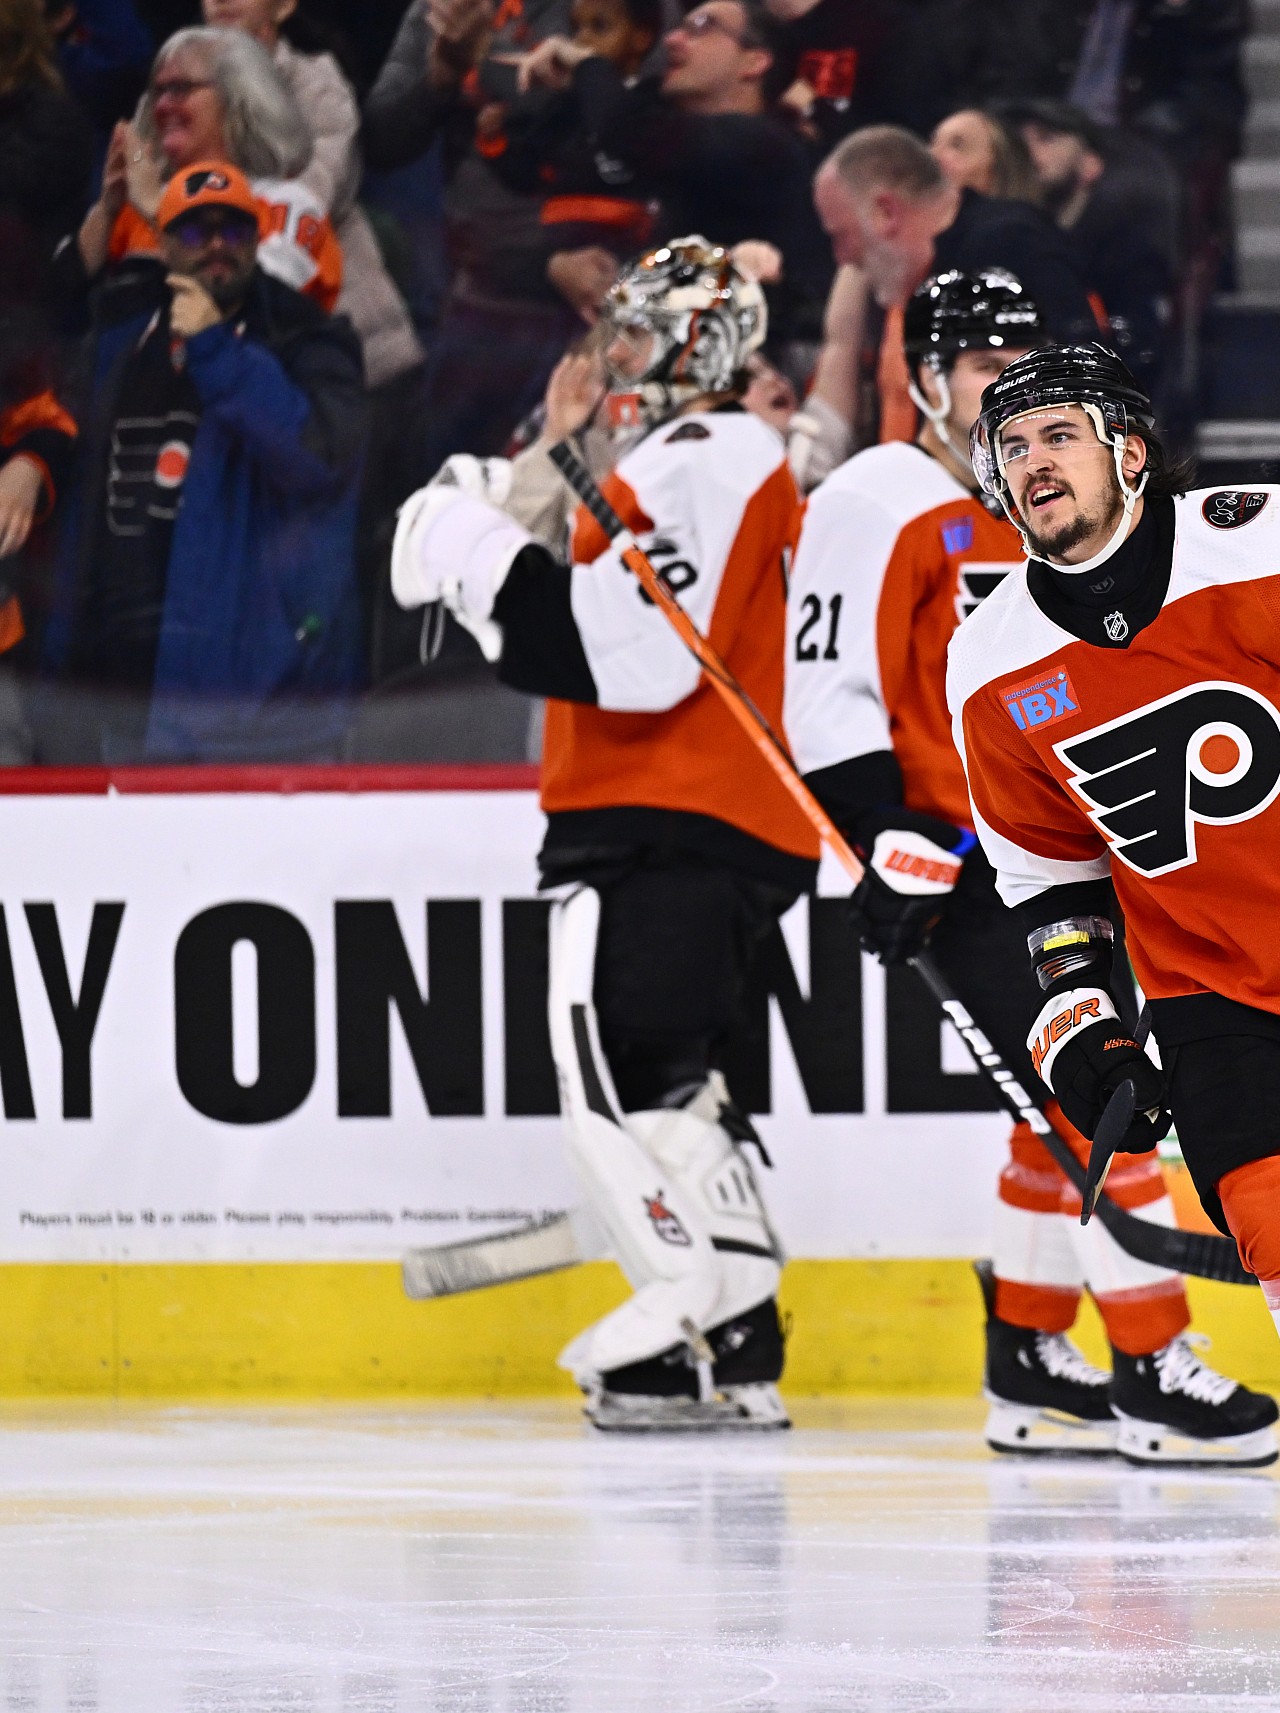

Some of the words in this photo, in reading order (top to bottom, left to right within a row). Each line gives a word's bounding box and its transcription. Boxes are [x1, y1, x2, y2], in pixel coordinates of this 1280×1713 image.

[994, 371, 1037, 395] BAUER
[796, 594, 842, 661] 21
[1004, 676, 1057, 702] Independence
[1008, 681, 1078, 730] IBX
